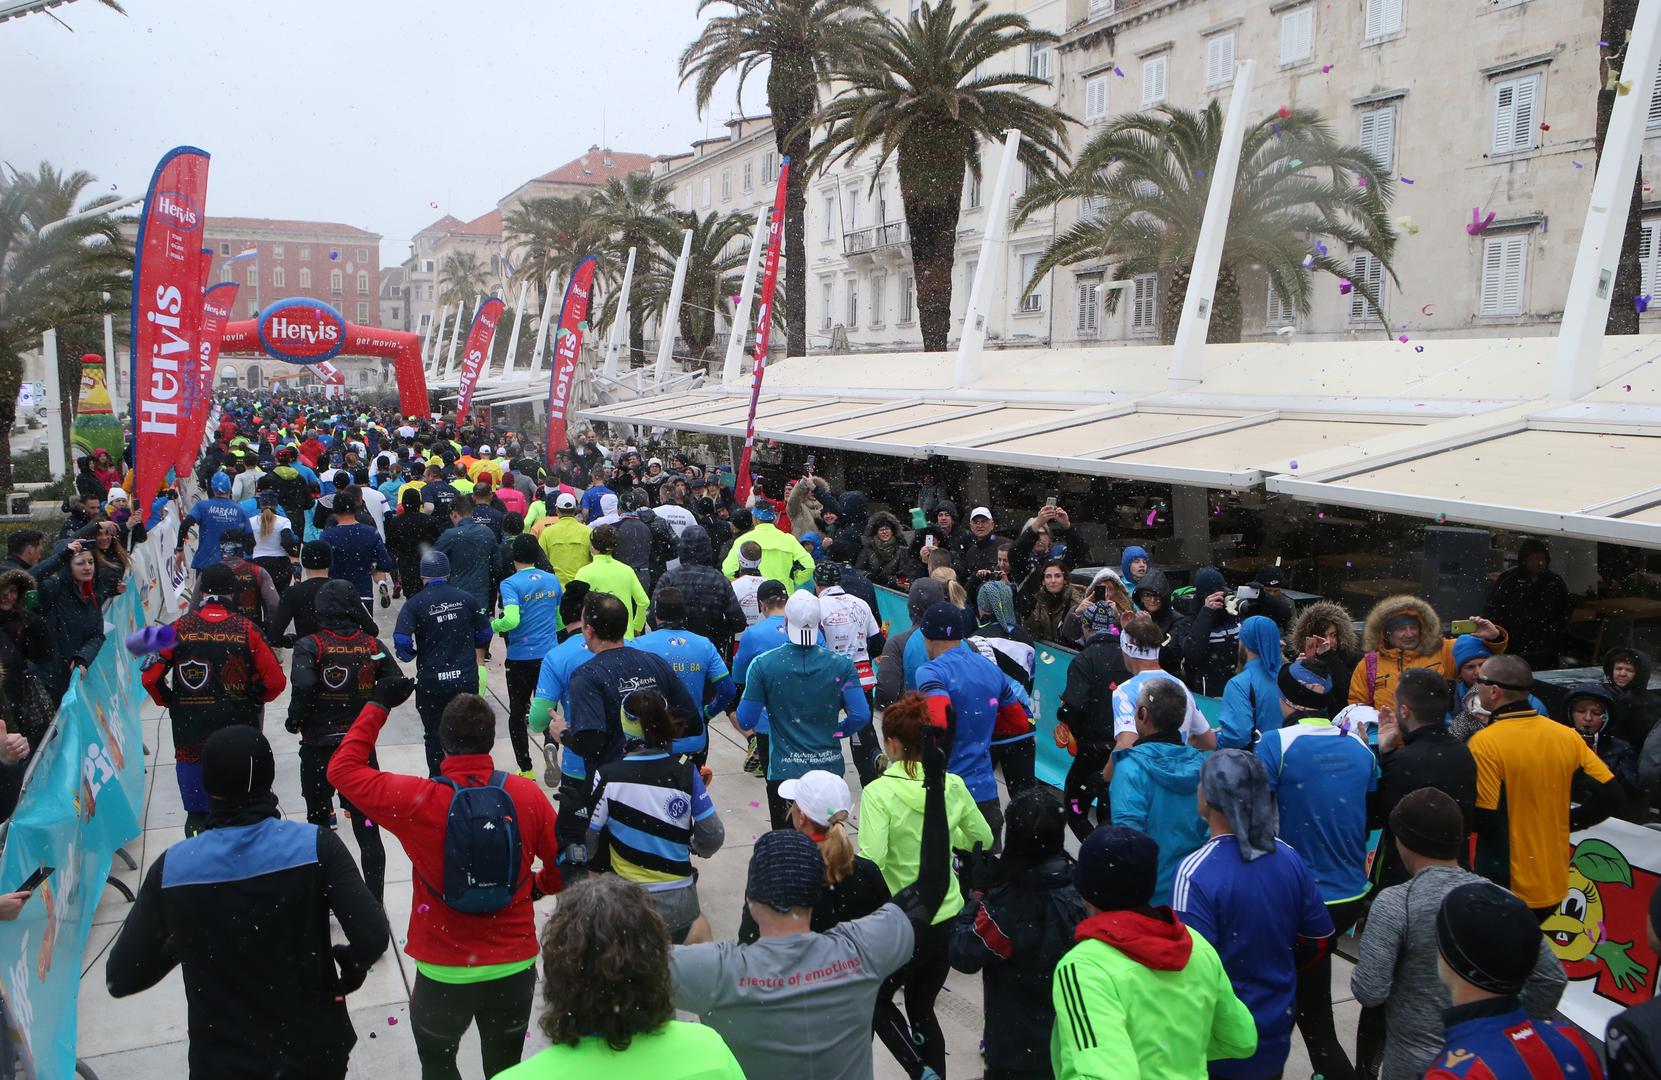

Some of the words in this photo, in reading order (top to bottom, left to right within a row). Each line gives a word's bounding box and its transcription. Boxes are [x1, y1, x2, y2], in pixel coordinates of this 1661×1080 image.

[159, 197, 196, 224] Hervis
[223, 332, 247, 342] ovin'
[272, 317, 338, 344] Hervis
[356, 337, 370, 346] get
[372, 341, 401, 349] movin'
[141, 284, 190, 436] Hervis
[445, 670, 461, 680] HEP
[672, 662, 685, 672] EU
[690, 662, 701, 672] BA
[788, 972, 801, 986] of
[804, 956, 862, 982] emotions
